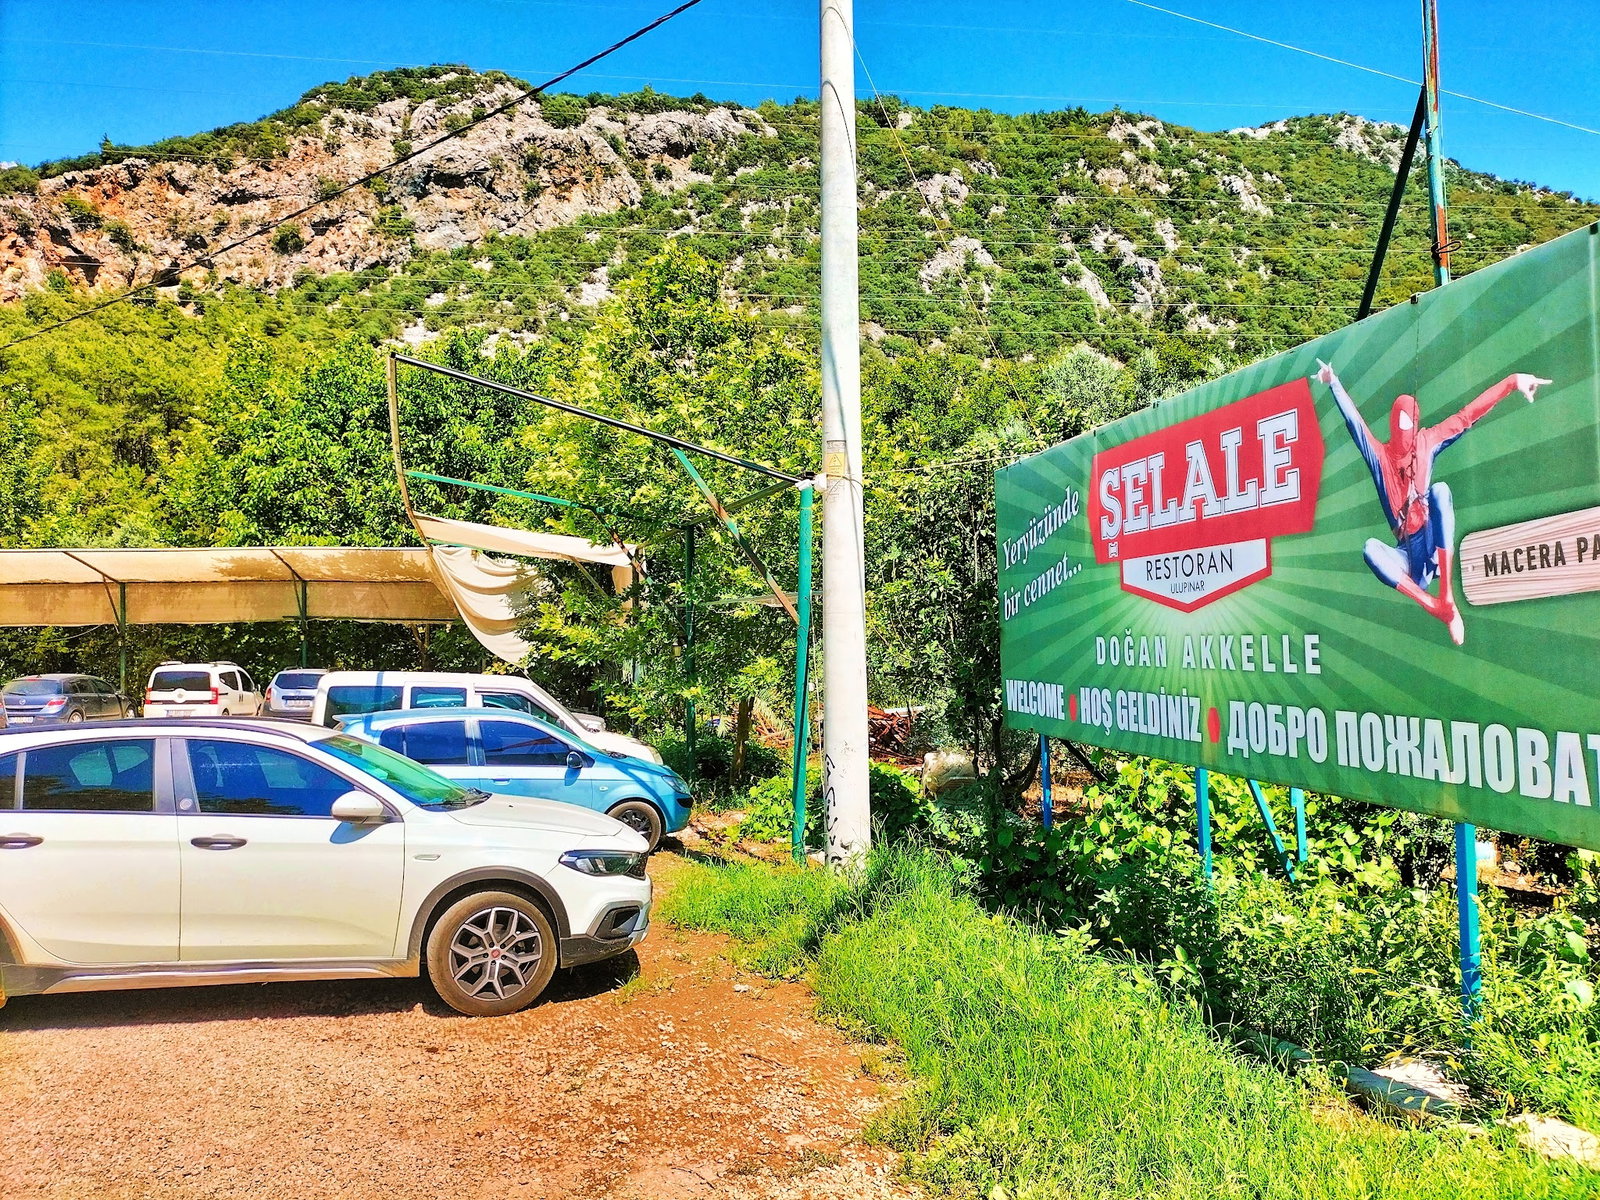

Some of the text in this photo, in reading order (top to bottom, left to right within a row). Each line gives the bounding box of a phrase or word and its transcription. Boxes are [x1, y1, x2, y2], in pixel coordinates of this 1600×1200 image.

[1100, 408, 1300, 558] ŞELALE
[1002, 485, 1079, 571] Yeryüzünde
[1483, 540, 1566, 577] MACERA
[1003, 551, 1082, 621] bir cennet...
[1146, 548, 1233, 581] RESTORAN
[1170, 580, 1205, 594] ULUPINAR
[1095, 628, 1322, 675] DOĞAN AKKELLE
[1005, 679, 1203, 743] WELCOME HOŞ GELDİNİZ
[1227, 700, 1328, 764] ДОБРО
